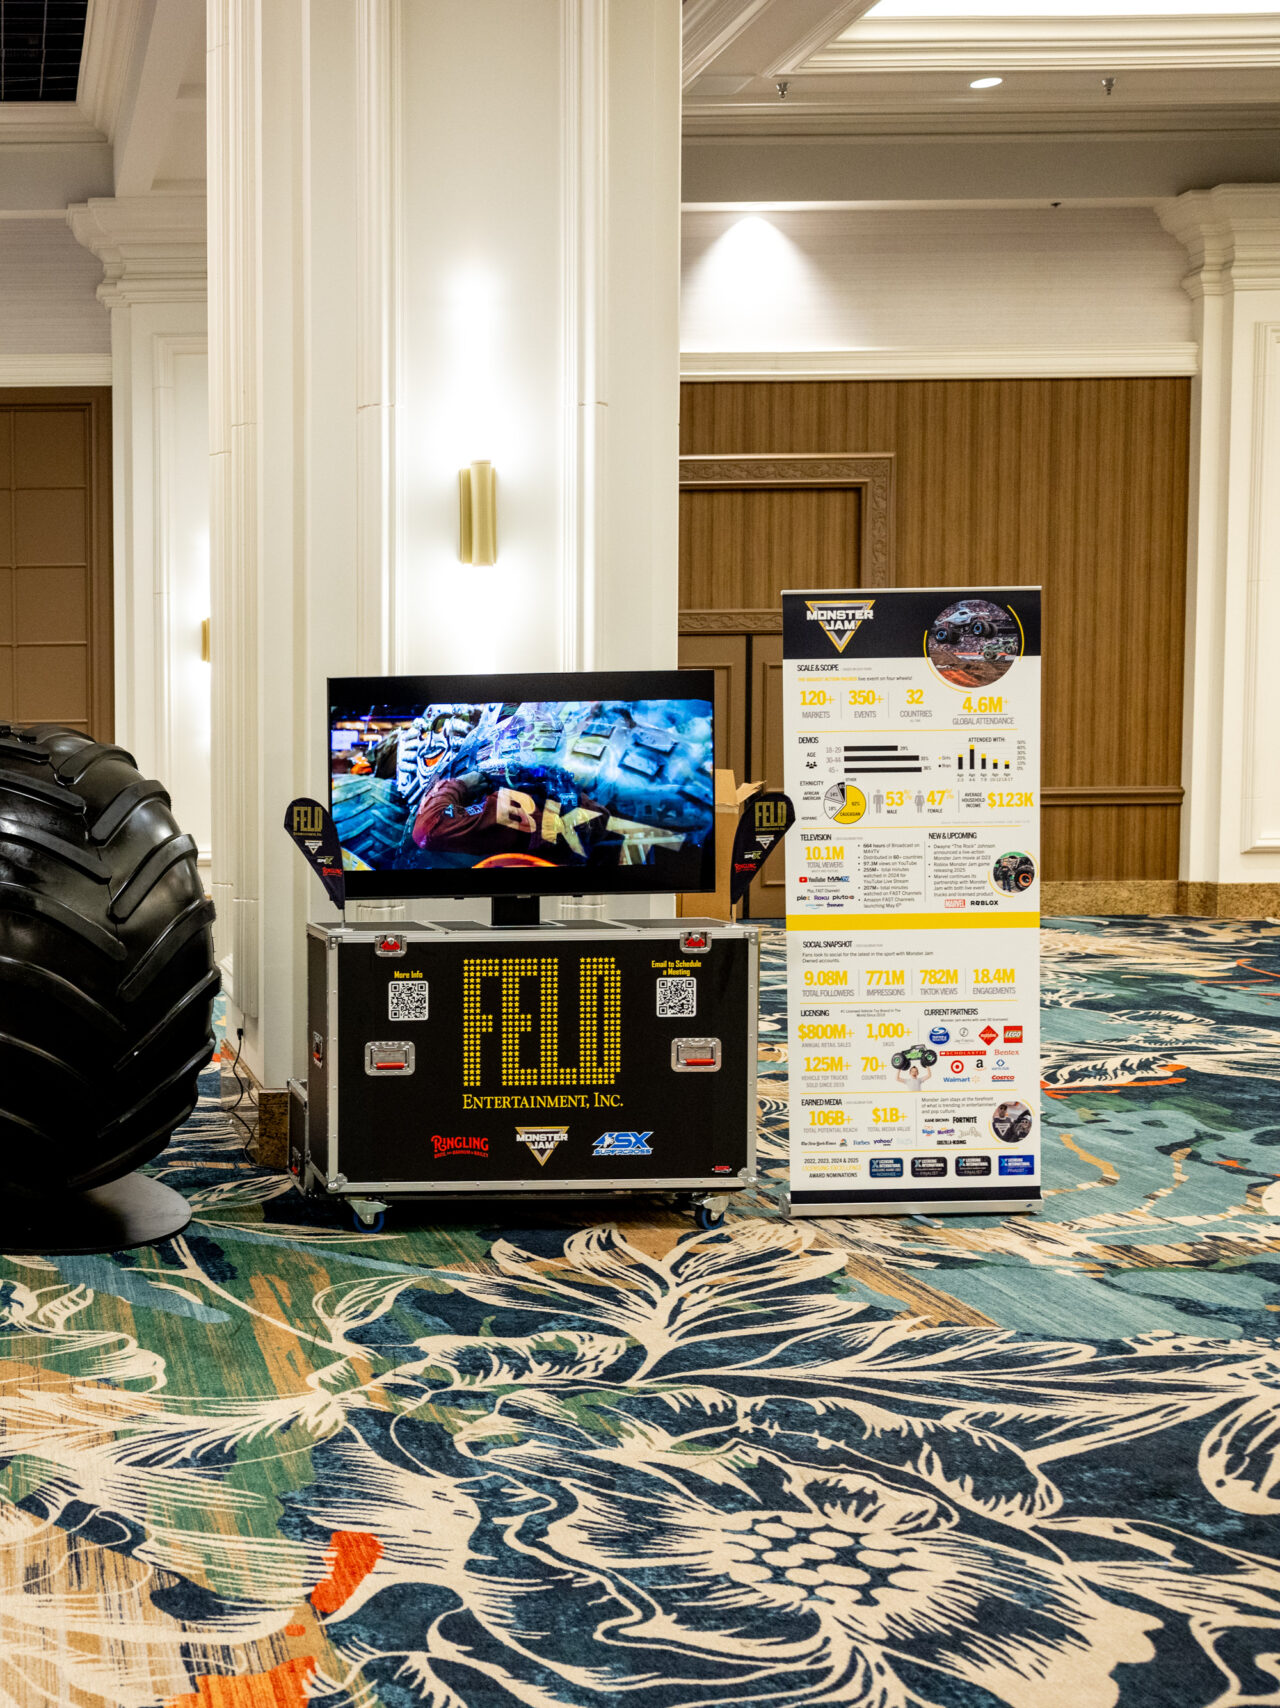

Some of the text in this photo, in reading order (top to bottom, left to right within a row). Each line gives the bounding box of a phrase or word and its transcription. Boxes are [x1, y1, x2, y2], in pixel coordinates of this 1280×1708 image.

[806, 609, 874, 620] MONSTER
[826, 620, 855, 630] JAM
[800, 690, 836, 706] 120+
[848, 690, 884, 705] 350+
[906, 689, 924, 704] 32
[900, 710, 932, 718] COUNTRIES
[976, 717, 1015, 725] ATTENDANCE
[987, 792, 1034, 809] $123K
[293, 806, 322, 832] FELD
[755, 802, 786, 827] FELD
[805, 846, 845, 860] 10.1M
[652, 960, 667, 968] Email
[394, 970, 423, 978] More Info
[668, 968, 690, 976] Meeting
[804, 970, 848, 986] 9.08M
[865, 970, 904, 985] 771M
[920, 969, 958, 984] 782M
[973, 968, 1015, 984] 18.4M
[820, 989, 855, 997] FOLLOWERS
[972, 987, 1016, 995] ENGAGEMENTS
[463, 957, 621, 1086] FELD
[798, 1023, 855, 1042] $800M+
[866, 1023, 912, 1040] 1,000+
[804, 1056, 852, 1072] 125M+
[861, 1056, 887, 1072] 70+
[809, 1110, 854, 1126] 106B+
[872, 1107, 908, 1125] $1B+
[430, 1134, 489, 1152] RINGLING
[517, 1133, 568, 1141] MONSTER
[531, 1141, 555, 1149] JAM
